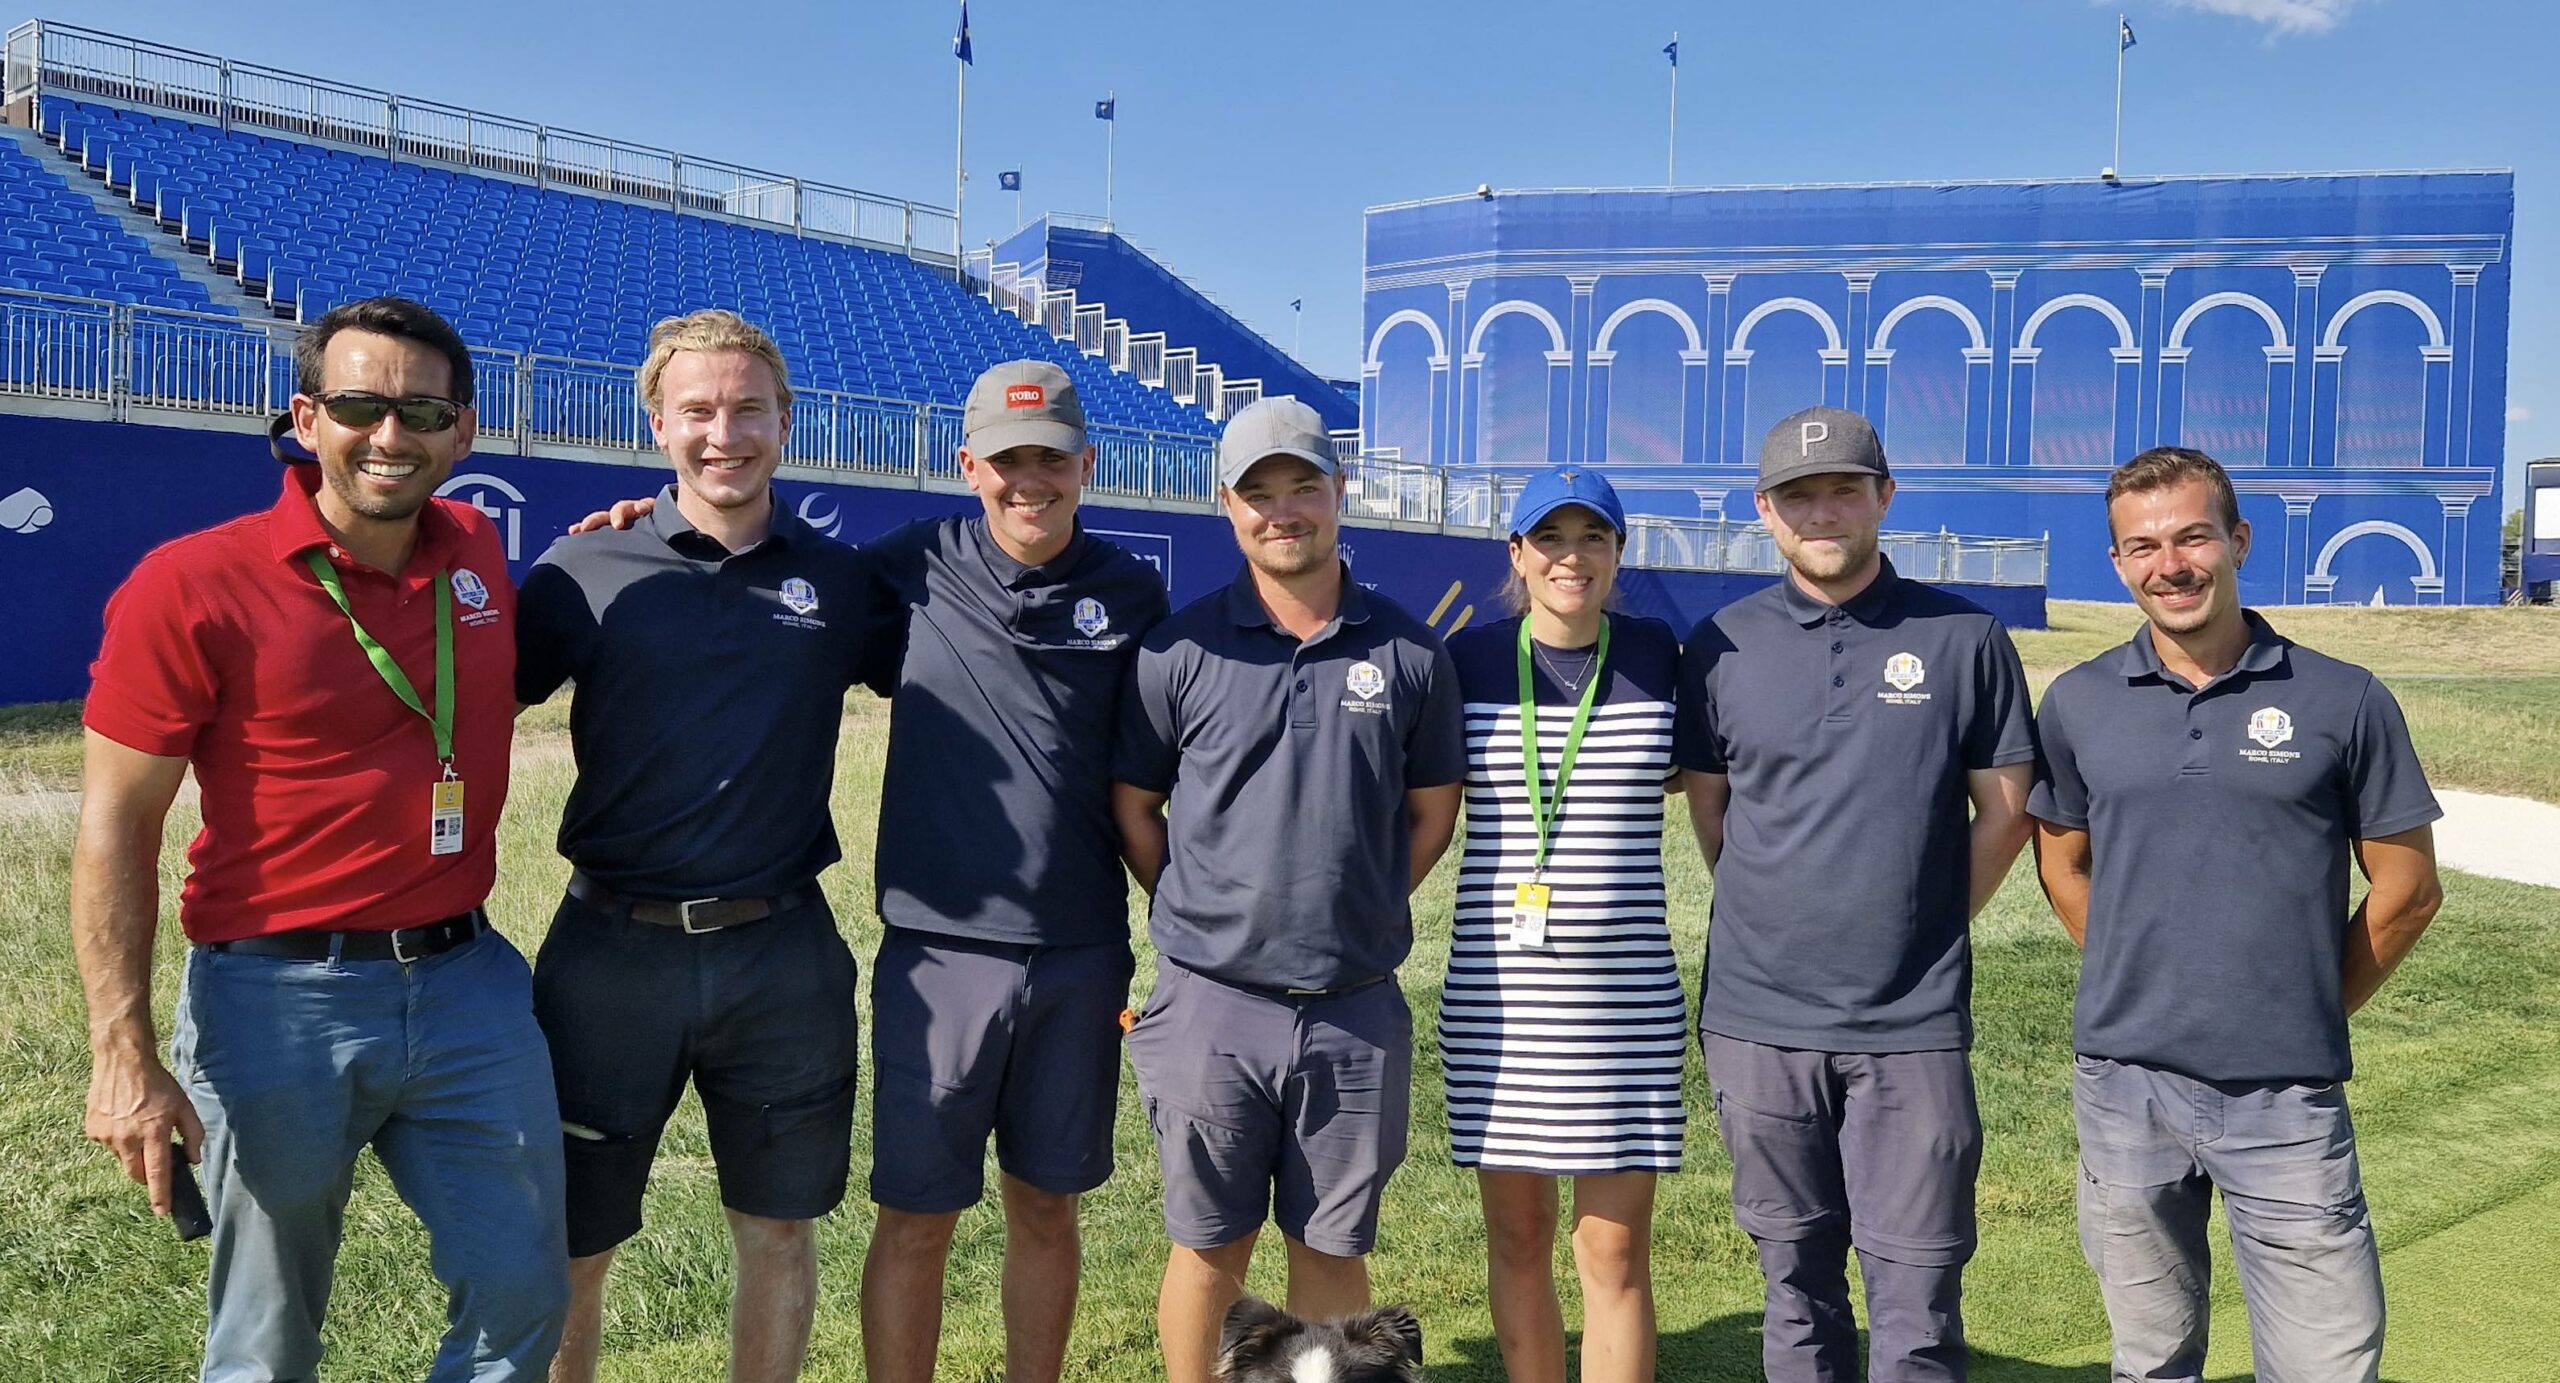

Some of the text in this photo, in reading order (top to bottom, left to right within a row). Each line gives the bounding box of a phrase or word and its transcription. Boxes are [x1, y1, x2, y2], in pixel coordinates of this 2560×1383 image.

[1008, 391, 1040, 402] TORO
[1802, 422, 1829, 457] P
[772, 613, 800, 622] MARCO
[1877, 691, 1903, 699] MARCO
[1340, 700, 1366, 708] MARCO
[2239, 749, 2301, 759] MARCO SIMONE
[2269, 757, 2290, 765] ITALY
